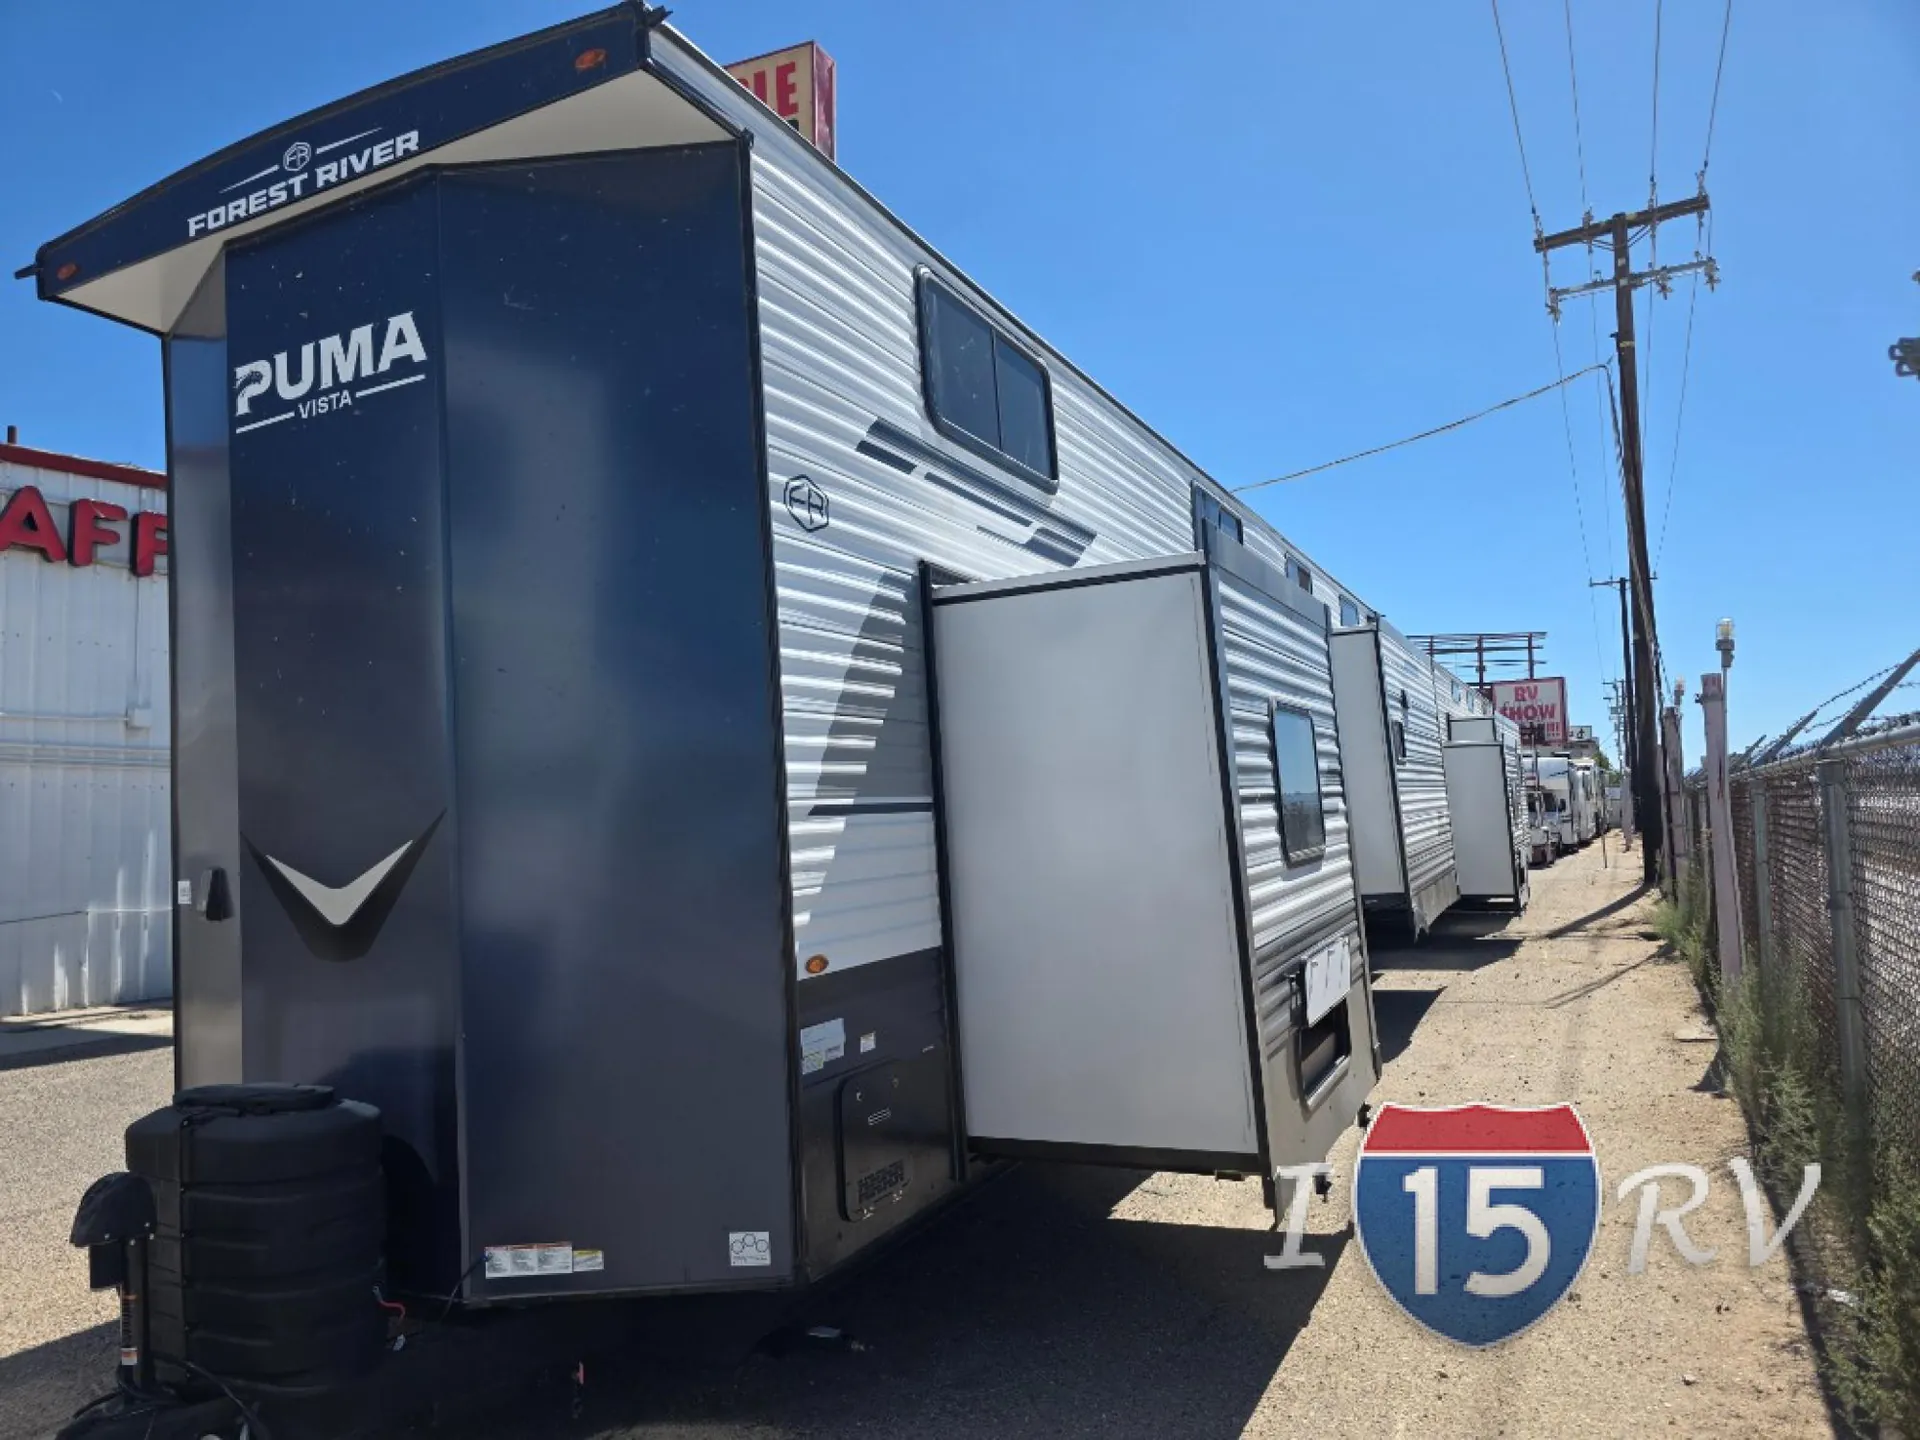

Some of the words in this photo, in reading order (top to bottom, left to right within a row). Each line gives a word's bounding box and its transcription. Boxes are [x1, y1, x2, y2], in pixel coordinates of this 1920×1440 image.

[187, 173, 308, 237] FOREST
[315, 130, 419, 188] RIVER
[234, 311, 428, 417] PUMA
[298, 390, 352, 419] VISTA
[1514, 685, 1538, 702] RV
